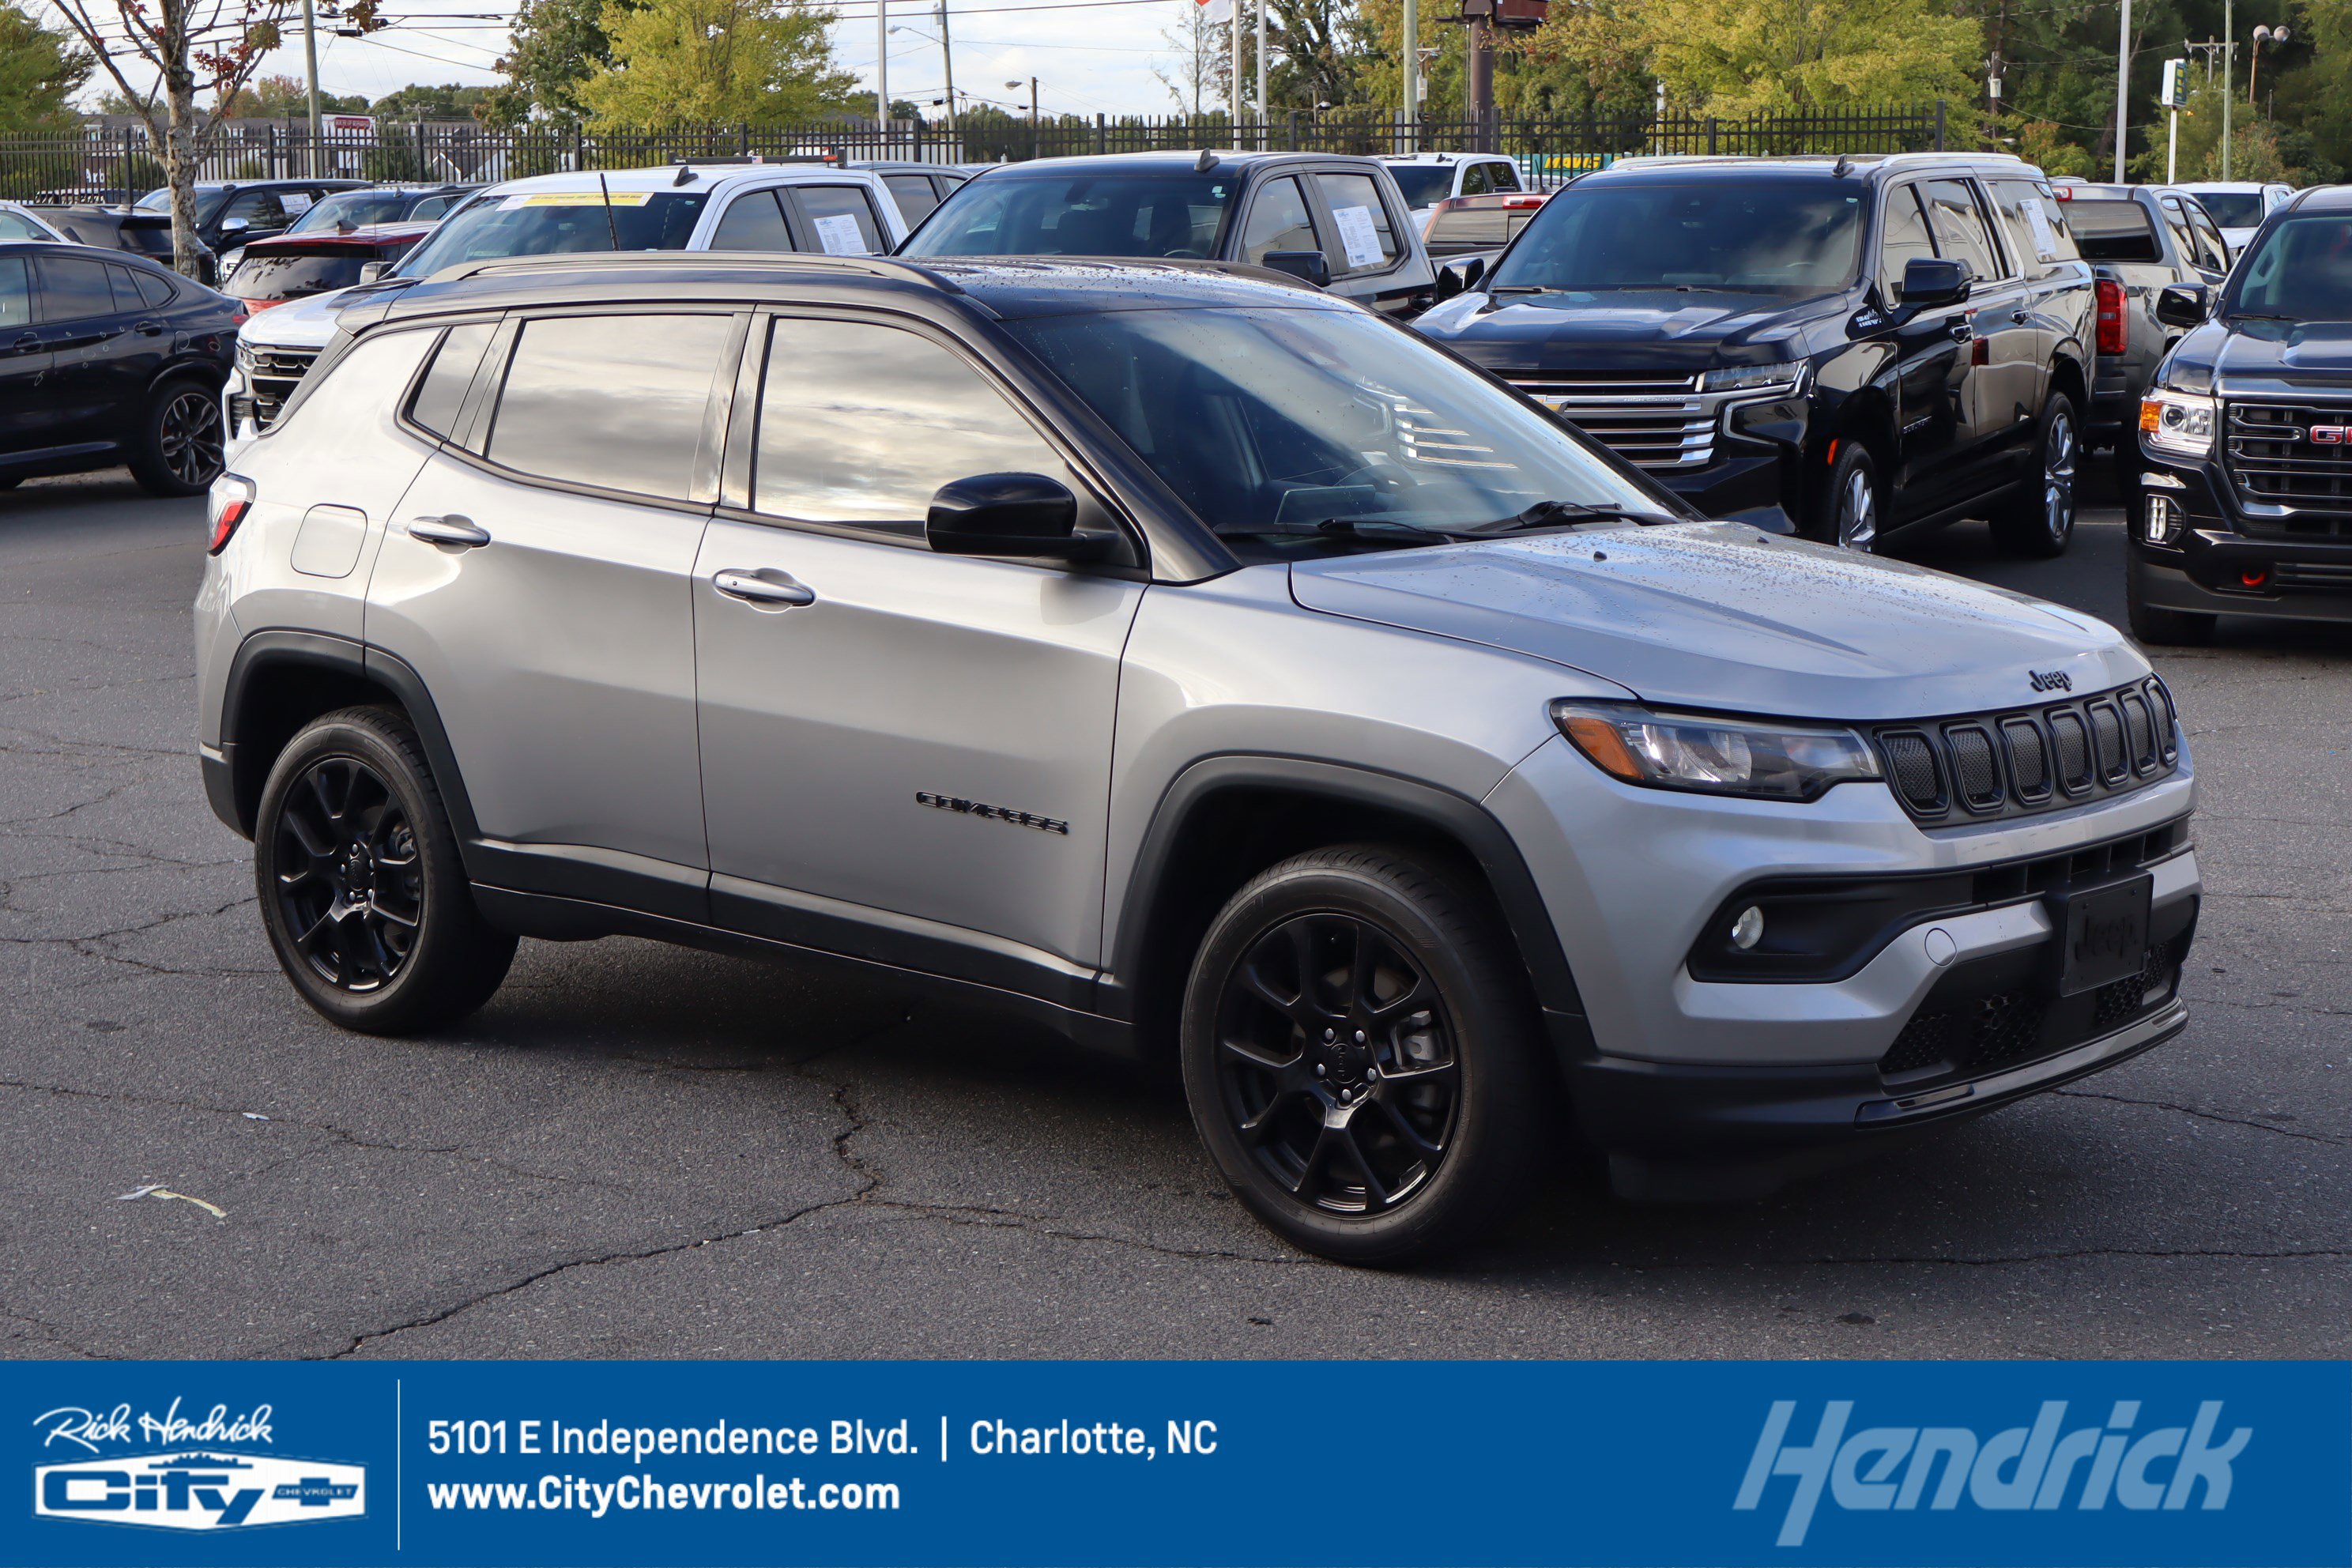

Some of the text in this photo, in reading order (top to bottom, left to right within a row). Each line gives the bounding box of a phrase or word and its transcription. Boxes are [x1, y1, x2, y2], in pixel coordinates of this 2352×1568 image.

[1544, 156, 1601, 169] MAVIS
[2028, 669, 2072, 692] Jeep
[2074, 914, 2137, 962] Jeep
